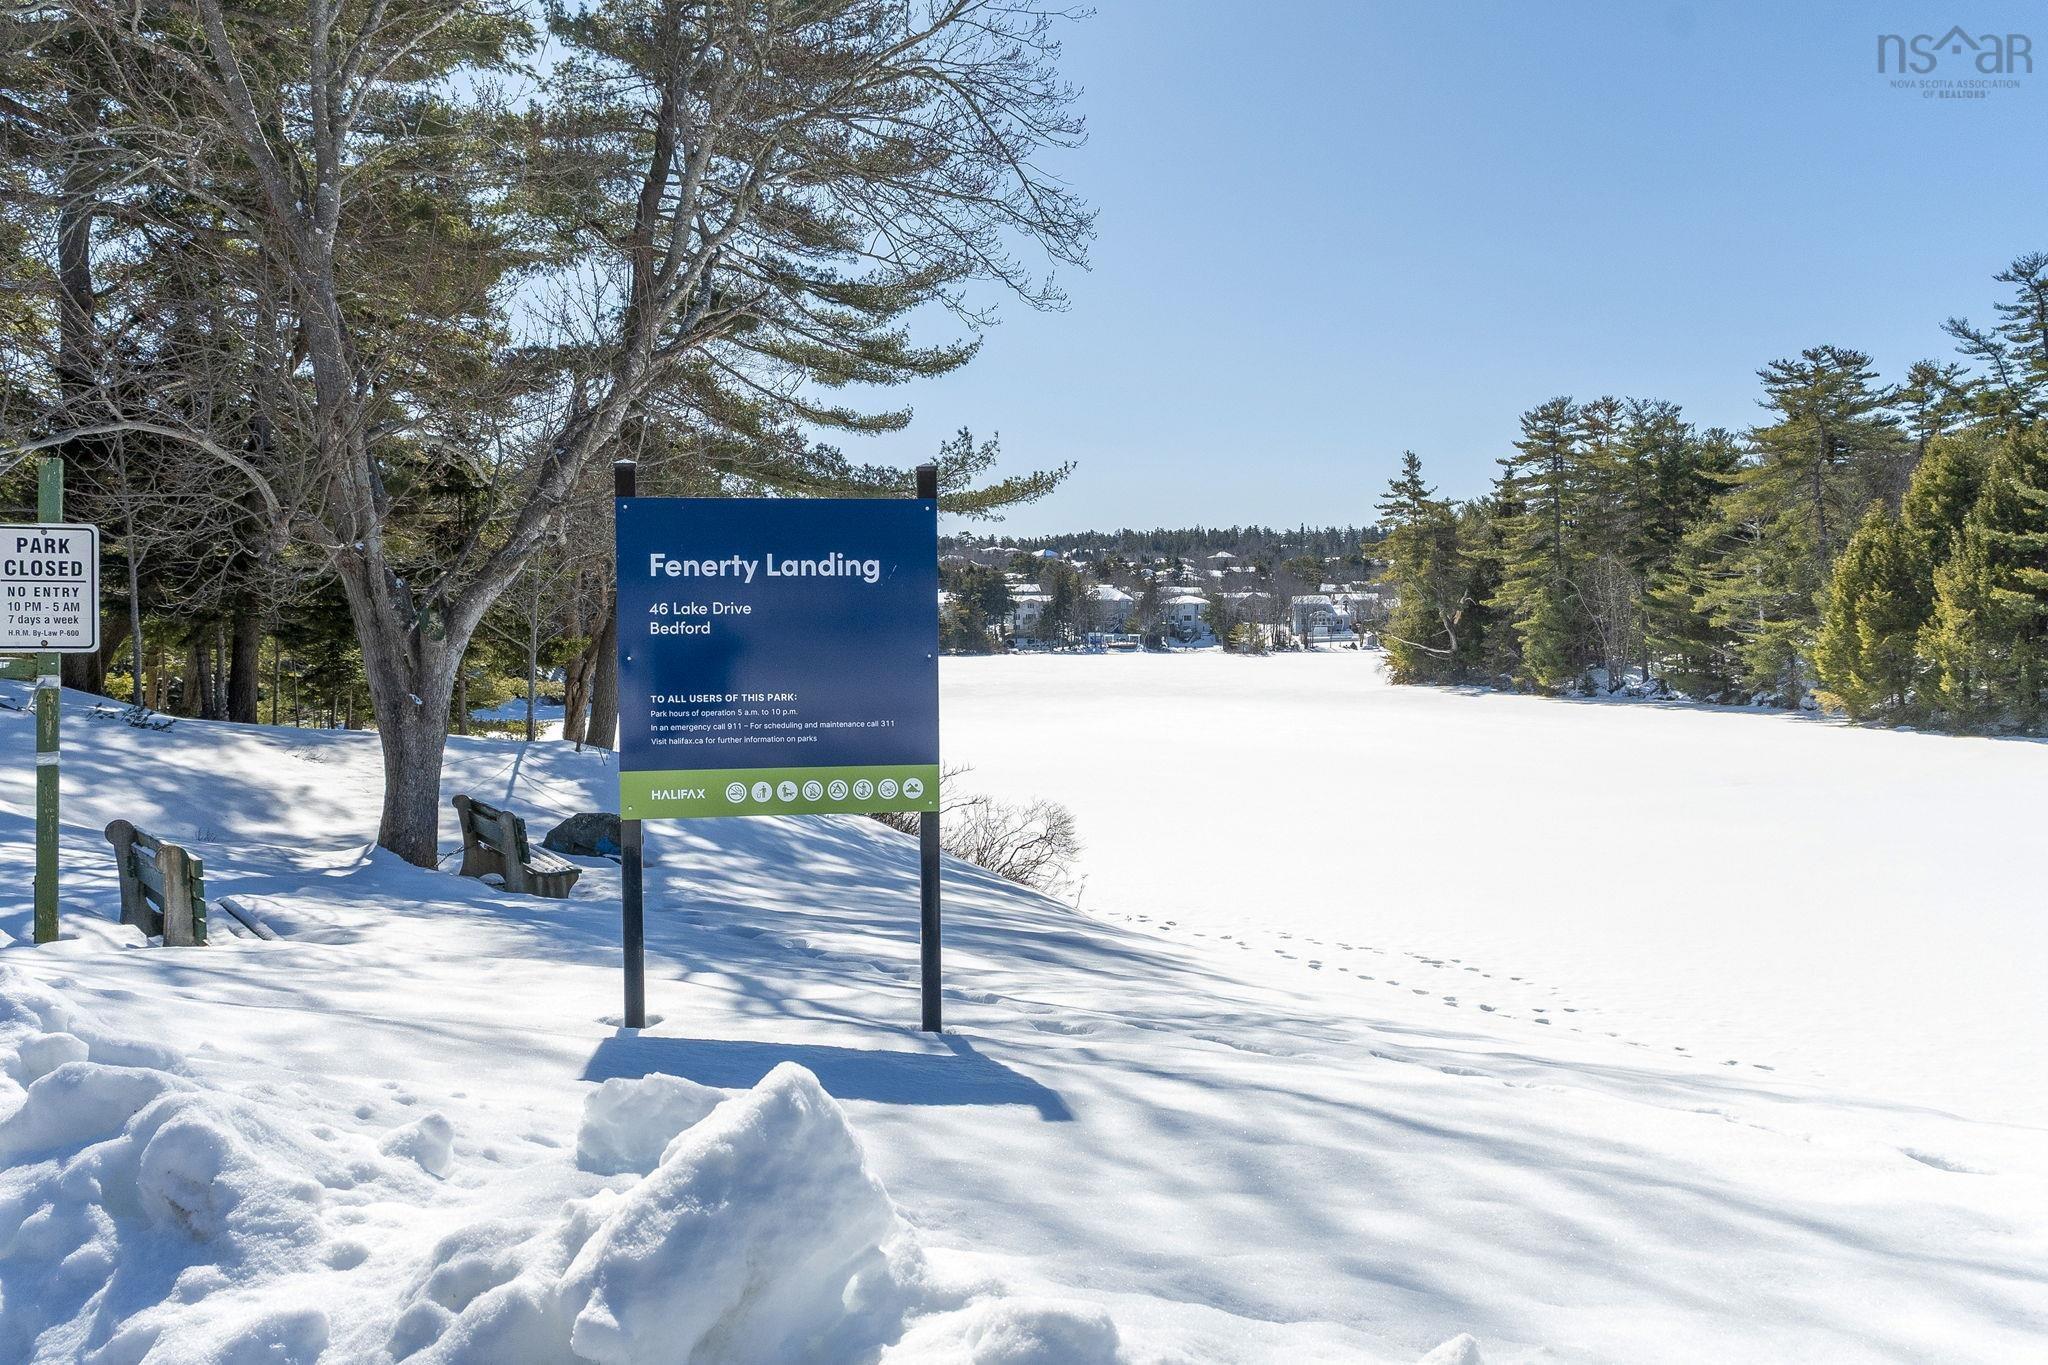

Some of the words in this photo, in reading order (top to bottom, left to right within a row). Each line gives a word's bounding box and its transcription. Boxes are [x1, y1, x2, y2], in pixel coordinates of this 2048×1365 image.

[17, 538, 70, 554] PARK
[5, 560, 83, 577] CLOSED
[650, 553, 759, 584] Fenerty
[766, 552, 880, 584] Landing
[8, 587, 26, 597] NO
[34, 587, 80, 598] ENTRY
[8, 602, 20, 611] 10
[25, 602, 41, 612] PM
[53, 602, 59, 612] 5
[63, 602, 80, 612] AM
[649, 603, 669, 615] 46
[673, 602, 708, 615] Lake
[712, 602, 752, 615] Drive
[9, 615, 14, 624] 7
[18, 615, 41, 626] days
[54, 615, 79, 624] week
[33, 630, 57, 638] By-Law
[650, 622, 711, 635] Bedford
[651, 695, 665, 704] TO
[668, 694, 687, 703] ALL
[689, 694, 723, 703] USERS
[725, 694, 739, 703] OF
[741, 693, 765, 702] THIS
[768, 693, 798, 702] PARK:
[691, 709, 699, 717] of
[701, 708, 736, 718] operation
[783, 709, 798, 717] p.m.
[670, 725, 711, 733] emergency
[750, 722, 762, 730] For
[764, 722, 803, 731] scheduling
[805, 721, 818, 729] and
[820, 720, 865, 728] maintenance
[669, 737, 704, 745] halifax.ca
[718, 736, 742, 744] further
[744, 735, 785, 743] information
[798, 735, 818, 743] parks
[652, 788, 706, 801] HALIFAX
